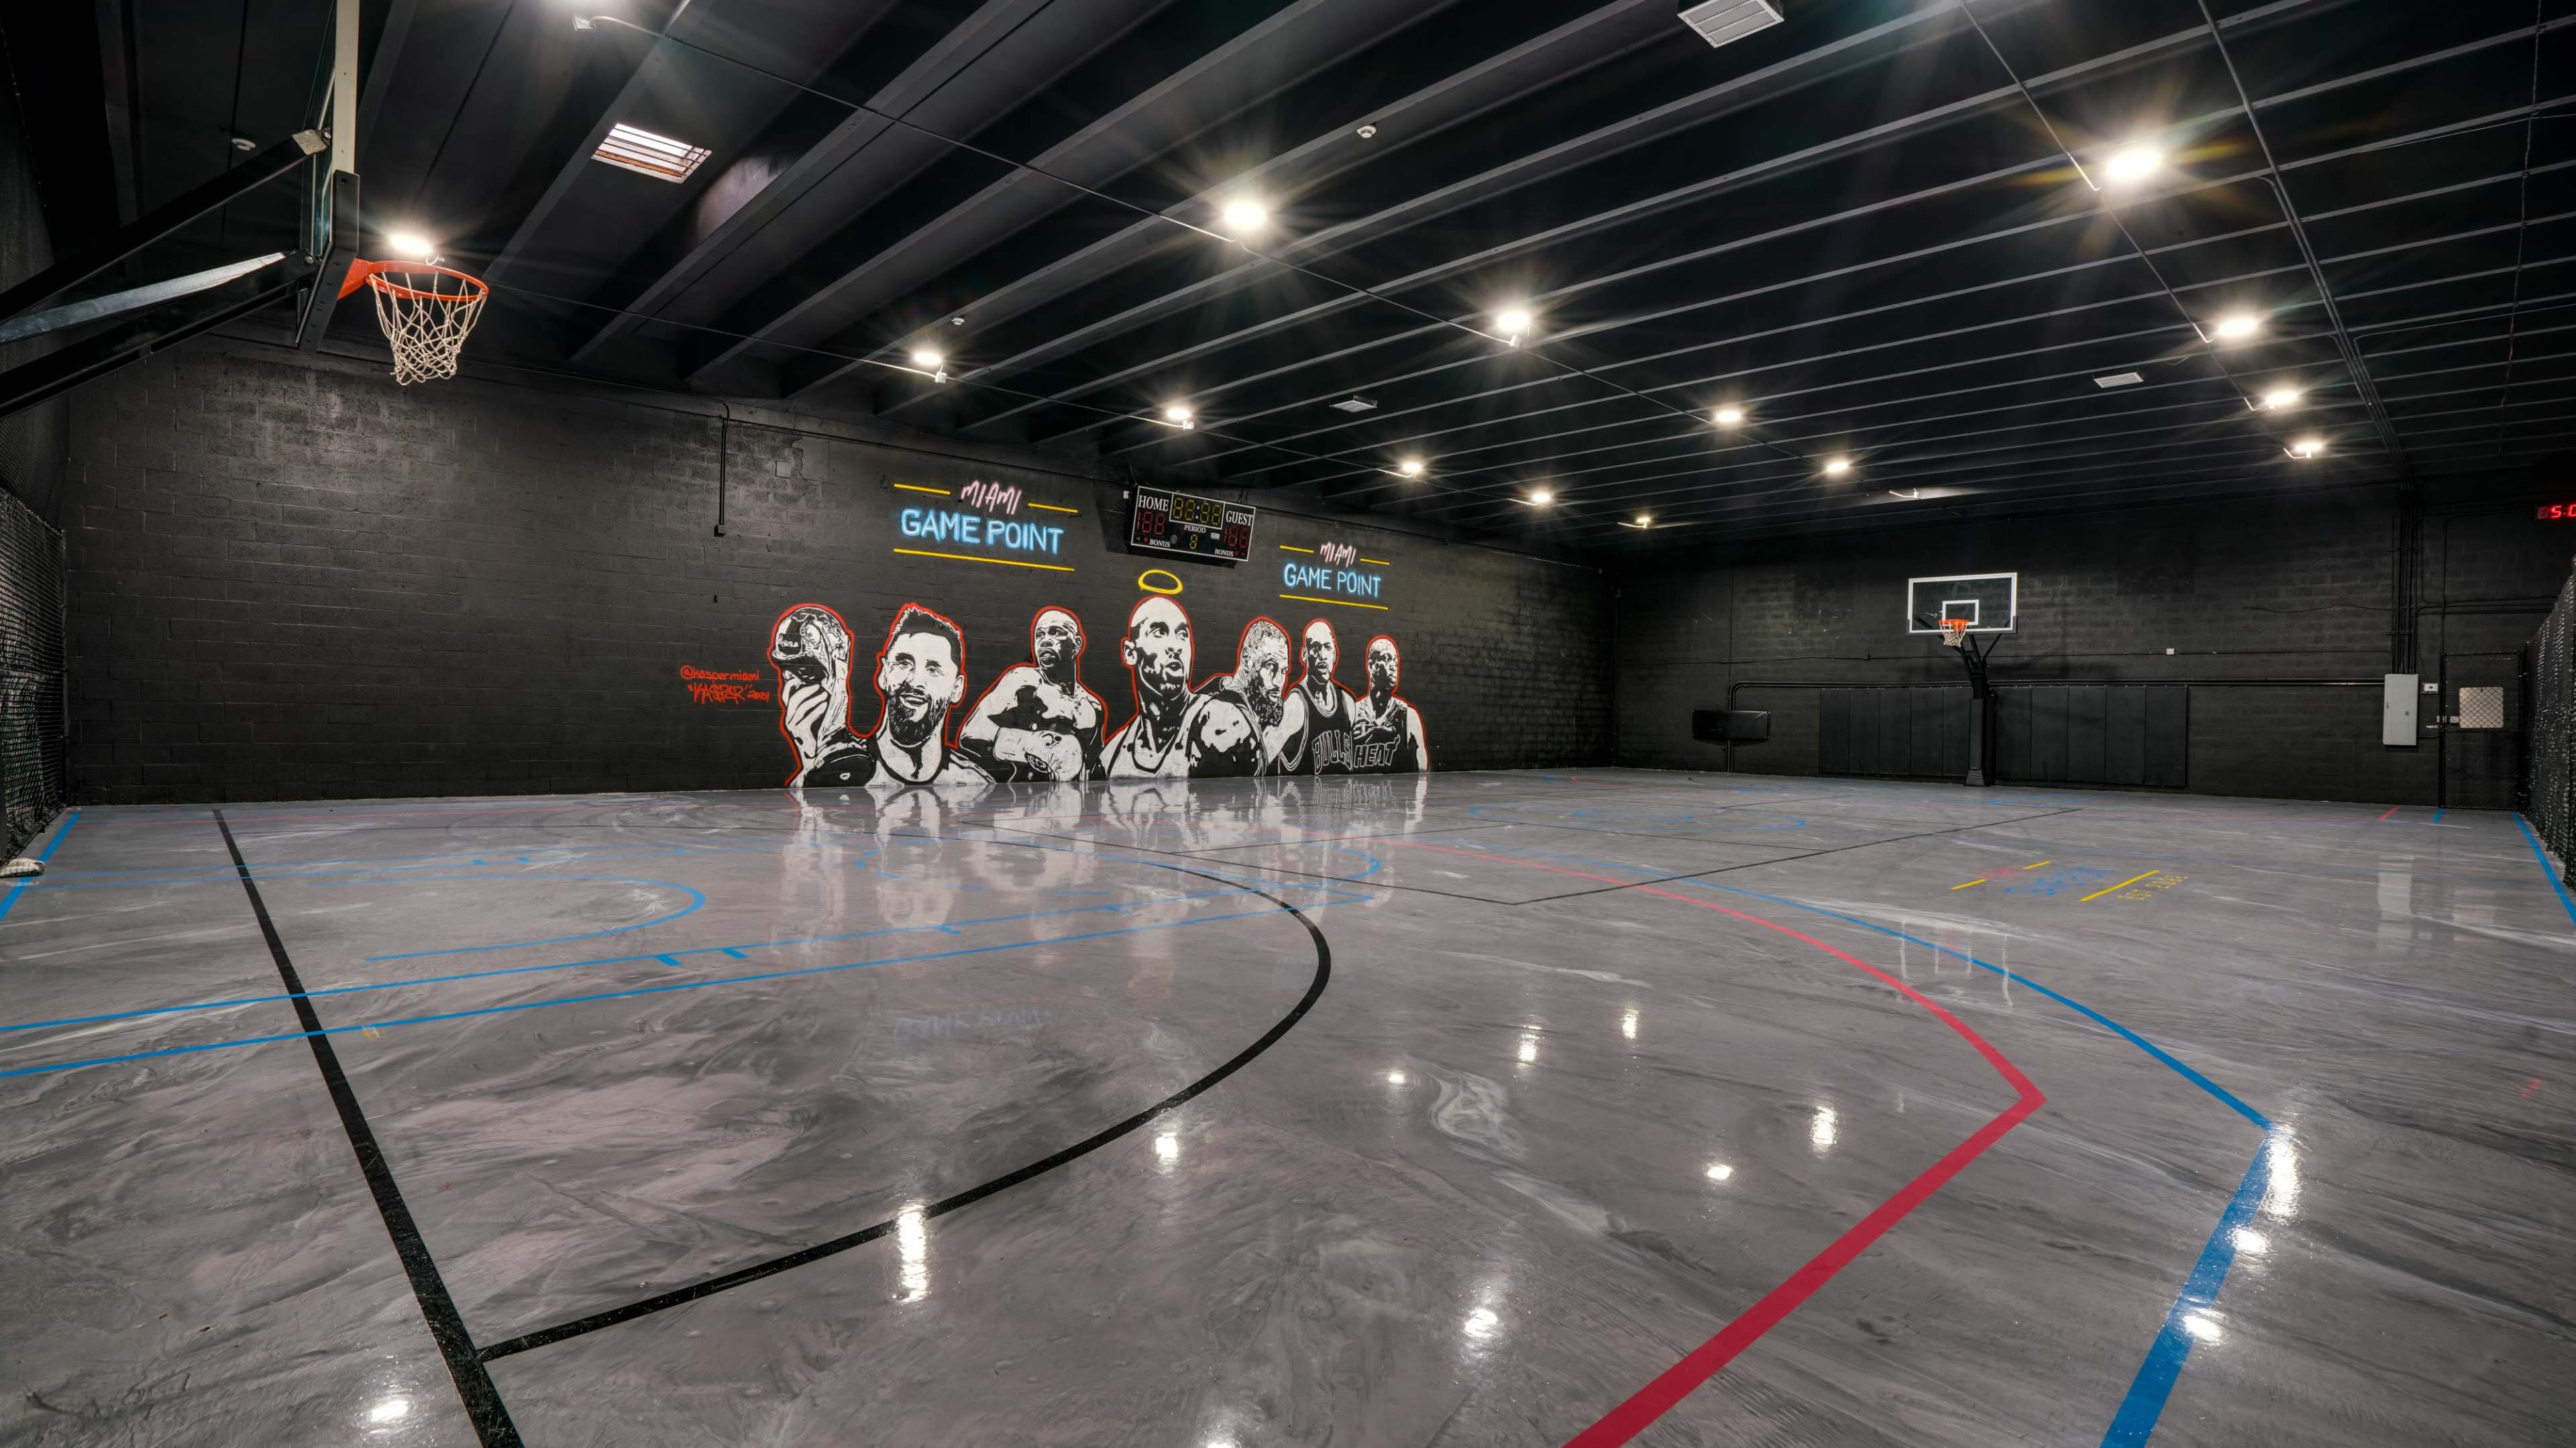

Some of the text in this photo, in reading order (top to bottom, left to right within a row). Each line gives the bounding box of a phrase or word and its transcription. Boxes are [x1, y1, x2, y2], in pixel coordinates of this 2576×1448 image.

[961, 480, 1022, 515] MIAMI
[1138, 494, 1169, 512] HOME
[901, 508, 1065, 555] GAME POINT
[1184, 524, 1206, 533] PERIOD
[1226, 510, 1254, 526] GUEST
[1149, 539, 1171, 548] BONUS
[1214, 549, 1234, 557] BONUS
[1320, 541, 1356, 568] MIAMI
[1283, 563, 1382, 598] GAME POINT
[1311, 730, 1352, 775] BULLS
[1354, 734, 1401, 768] HEAT
